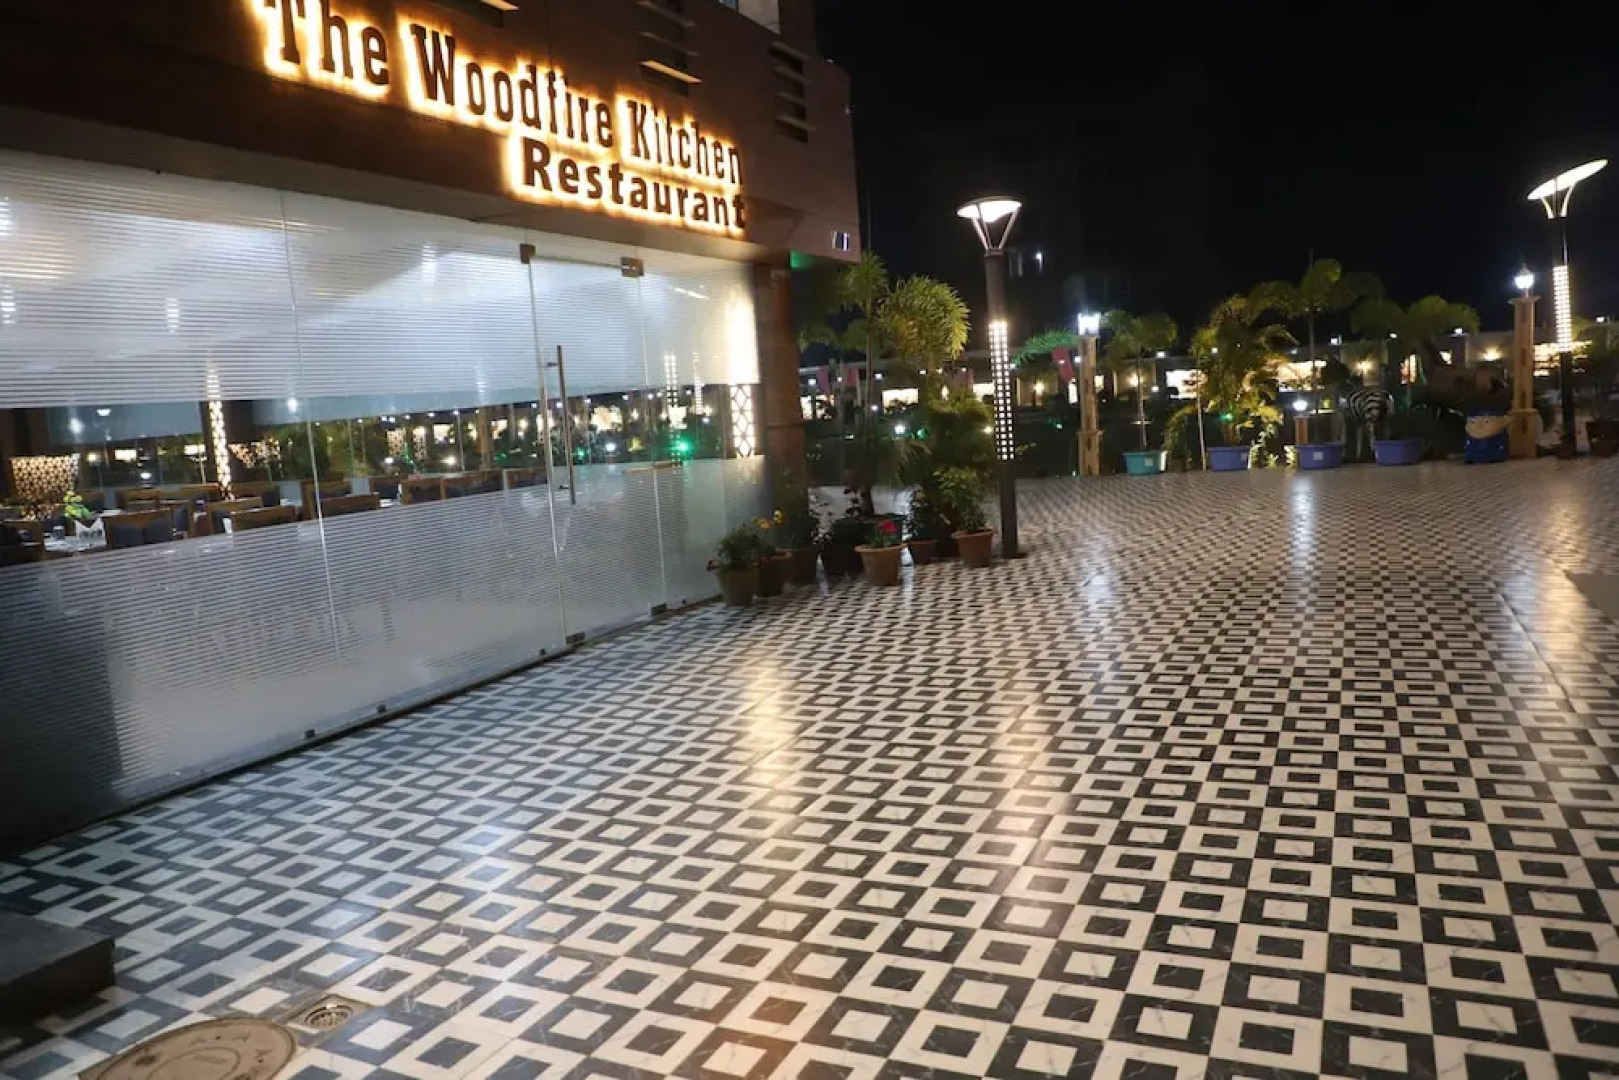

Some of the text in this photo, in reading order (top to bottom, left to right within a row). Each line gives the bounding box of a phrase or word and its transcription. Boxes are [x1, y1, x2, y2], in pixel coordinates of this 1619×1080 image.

[410, 23, 613, 148] Woodfire
[626, 99, 743, 185] Kitchen
[521, 136, 746, 229] Restaurant
